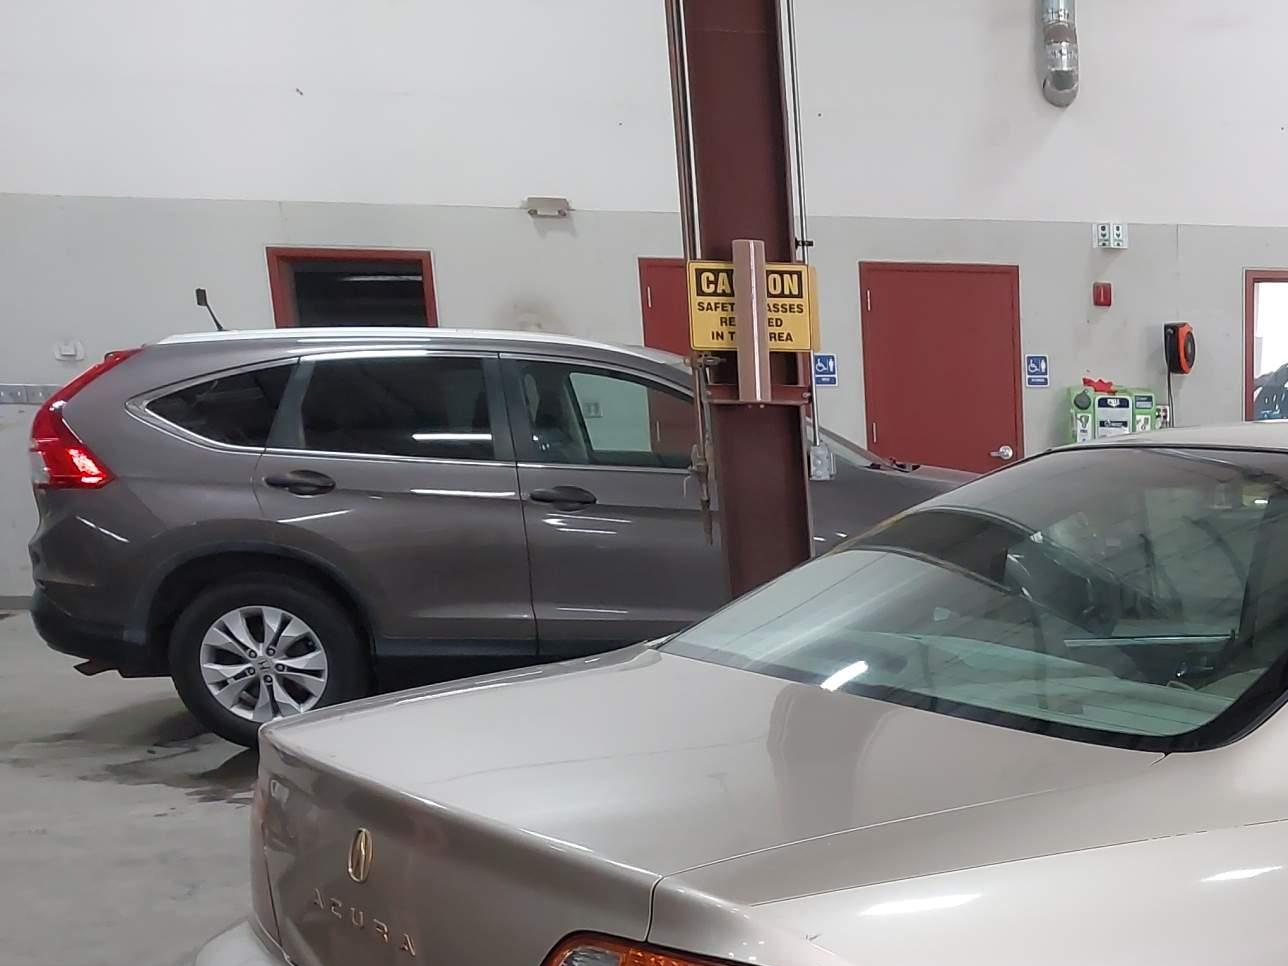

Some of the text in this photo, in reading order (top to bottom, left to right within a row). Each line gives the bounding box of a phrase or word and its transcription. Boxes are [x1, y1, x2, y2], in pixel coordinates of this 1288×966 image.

[701, 271, 799, 296] CAON
[697, 302, 804, 314] SAFET ASSES
[720, 316, 783, 328] REED
[711, 331, 724, 341] IN
[769, 332, 793, 342] REA
